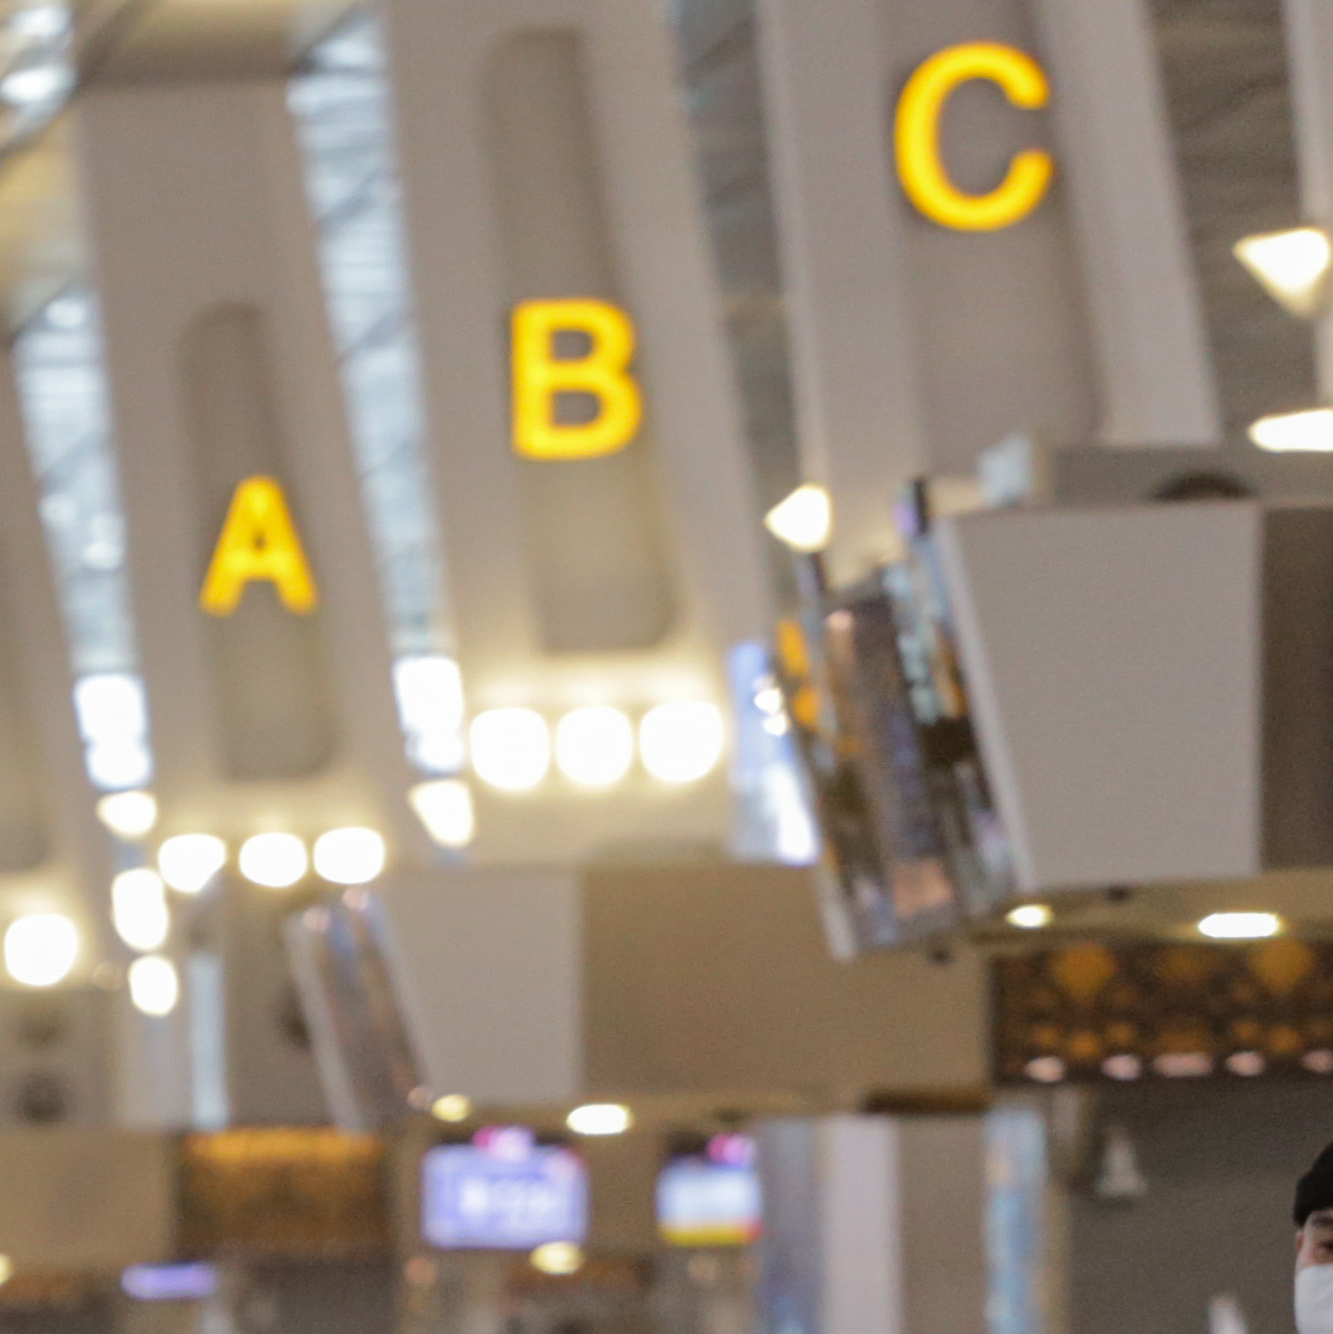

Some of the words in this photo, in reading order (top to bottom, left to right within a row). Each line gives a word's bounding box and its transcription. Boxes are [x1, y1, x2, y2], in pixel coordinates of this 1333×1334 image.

[893, 40, 1052, 232] C
[510, 297, 643, 462] B
[199, 475, 319, 616] A
